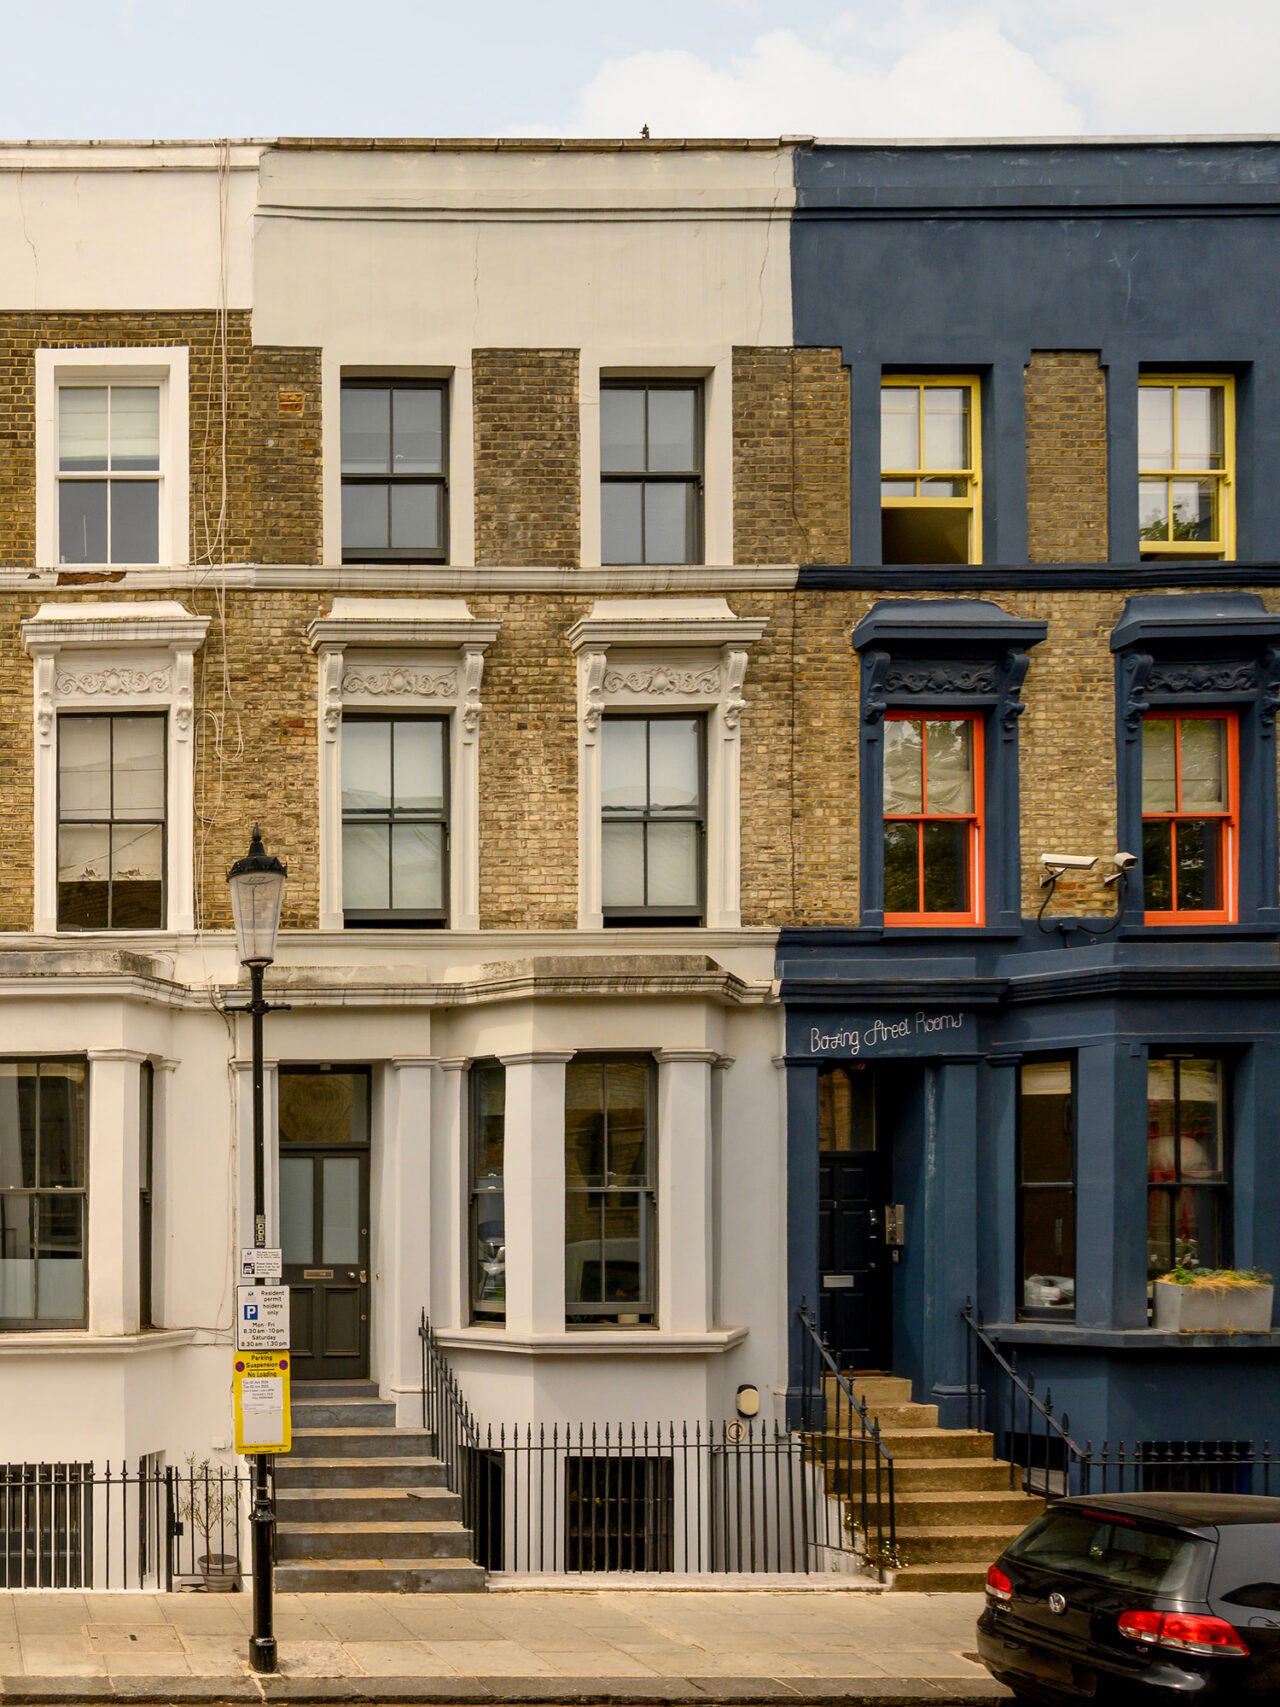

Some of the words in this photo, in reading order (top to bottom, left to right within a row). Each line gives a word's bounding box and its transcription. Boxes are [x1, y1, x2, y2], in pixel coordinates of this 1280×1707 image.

[863, 1018, 911, 1046] Street
[915, 1011, 964, 1034] Rooms
[246, 1306, 256, 1320] P
